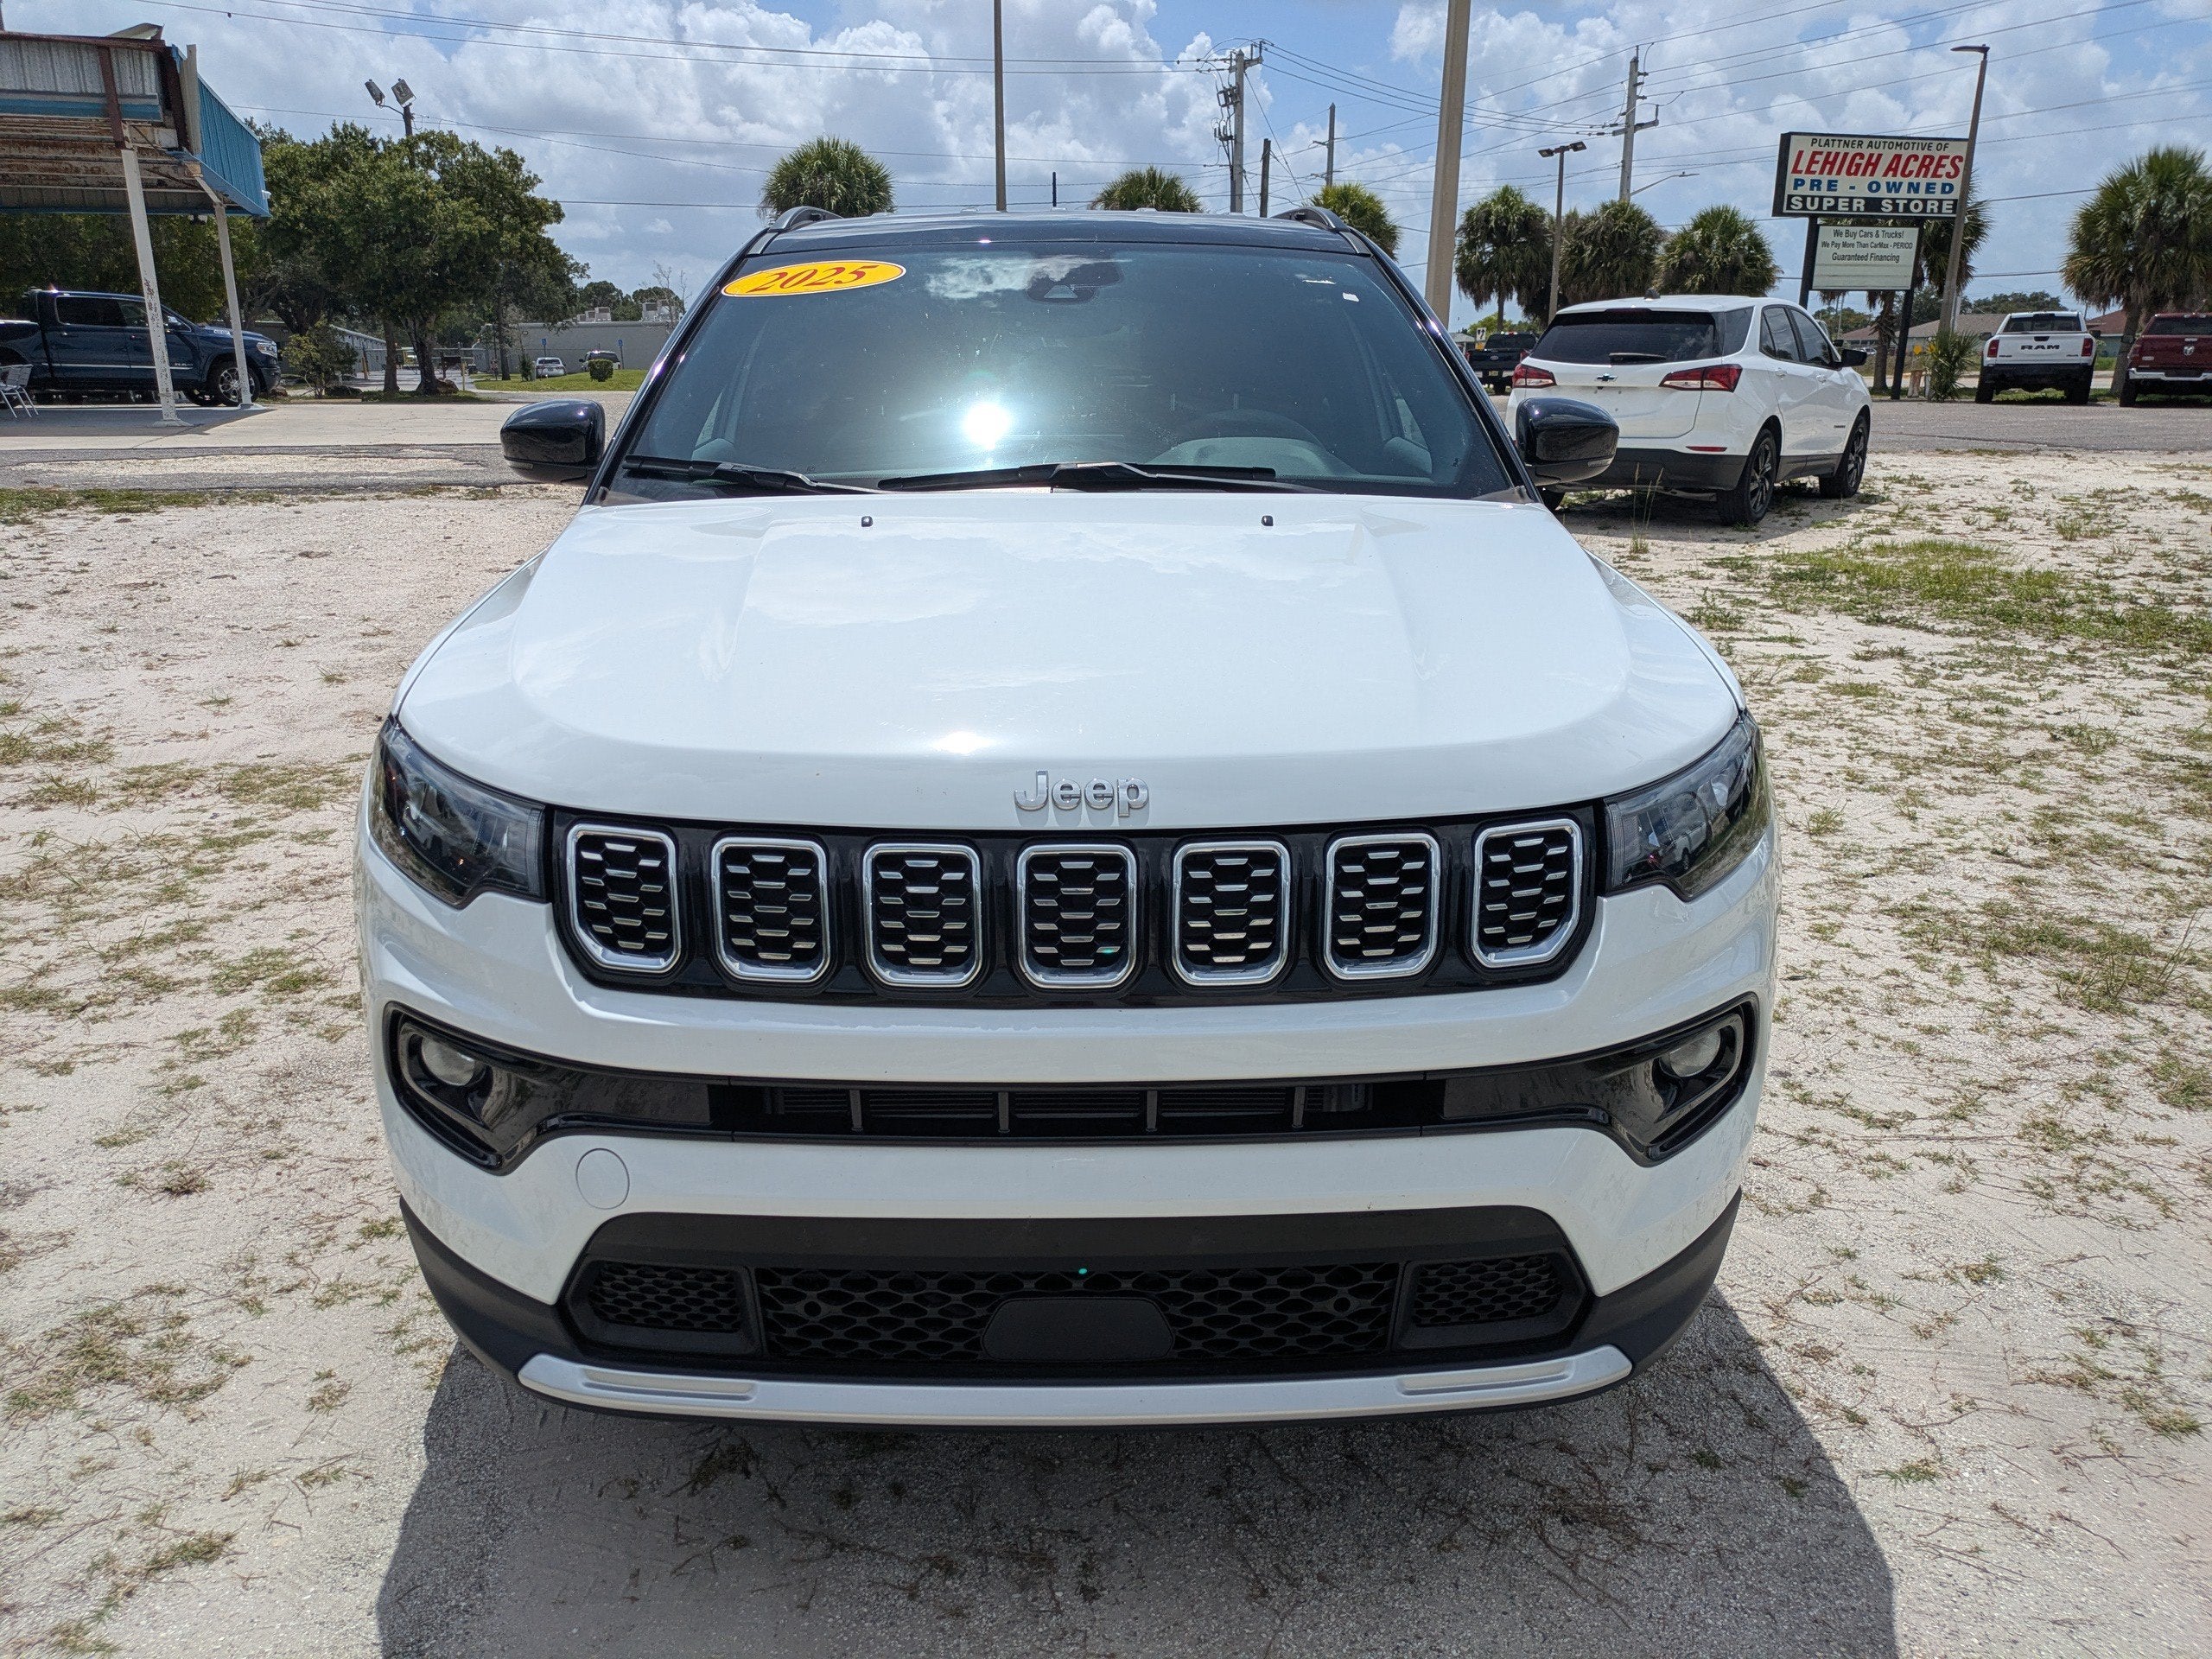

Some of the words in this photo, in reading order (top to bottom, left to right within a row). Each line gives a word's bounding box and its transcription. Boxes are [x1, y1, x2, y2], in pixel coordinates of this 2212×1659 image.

[1810, 137, 1864, 149] PLATTNER
[1866, 140, 1933, 151] AUTOMOTIVE
[1936, 143, 1949, 151] OF
[1790, 149, 1883, 177] LEHIGH
[1882, 153, 1964, 180] ACRES
[1867, 180, 1955, 195] OWNED
[1790, 196, 1866, 212] SUPER
[1880, 199, 1955, 213] STORE
[1833, 229, 1843, 238] We
[1845, 229, 1858, 239] Buy
[1859, 230, 1873, 238] Cars
[1874, 230, 1880, 238] &
[1882, 230, 1904, 239] Trucks!
[1832, 252, 1869, 262] Guaranteed
[1870, 253, 1900, 264] Financing
[745, 264, 879, 294] 2025
[1014, 769, 1148, 817] Jeep
